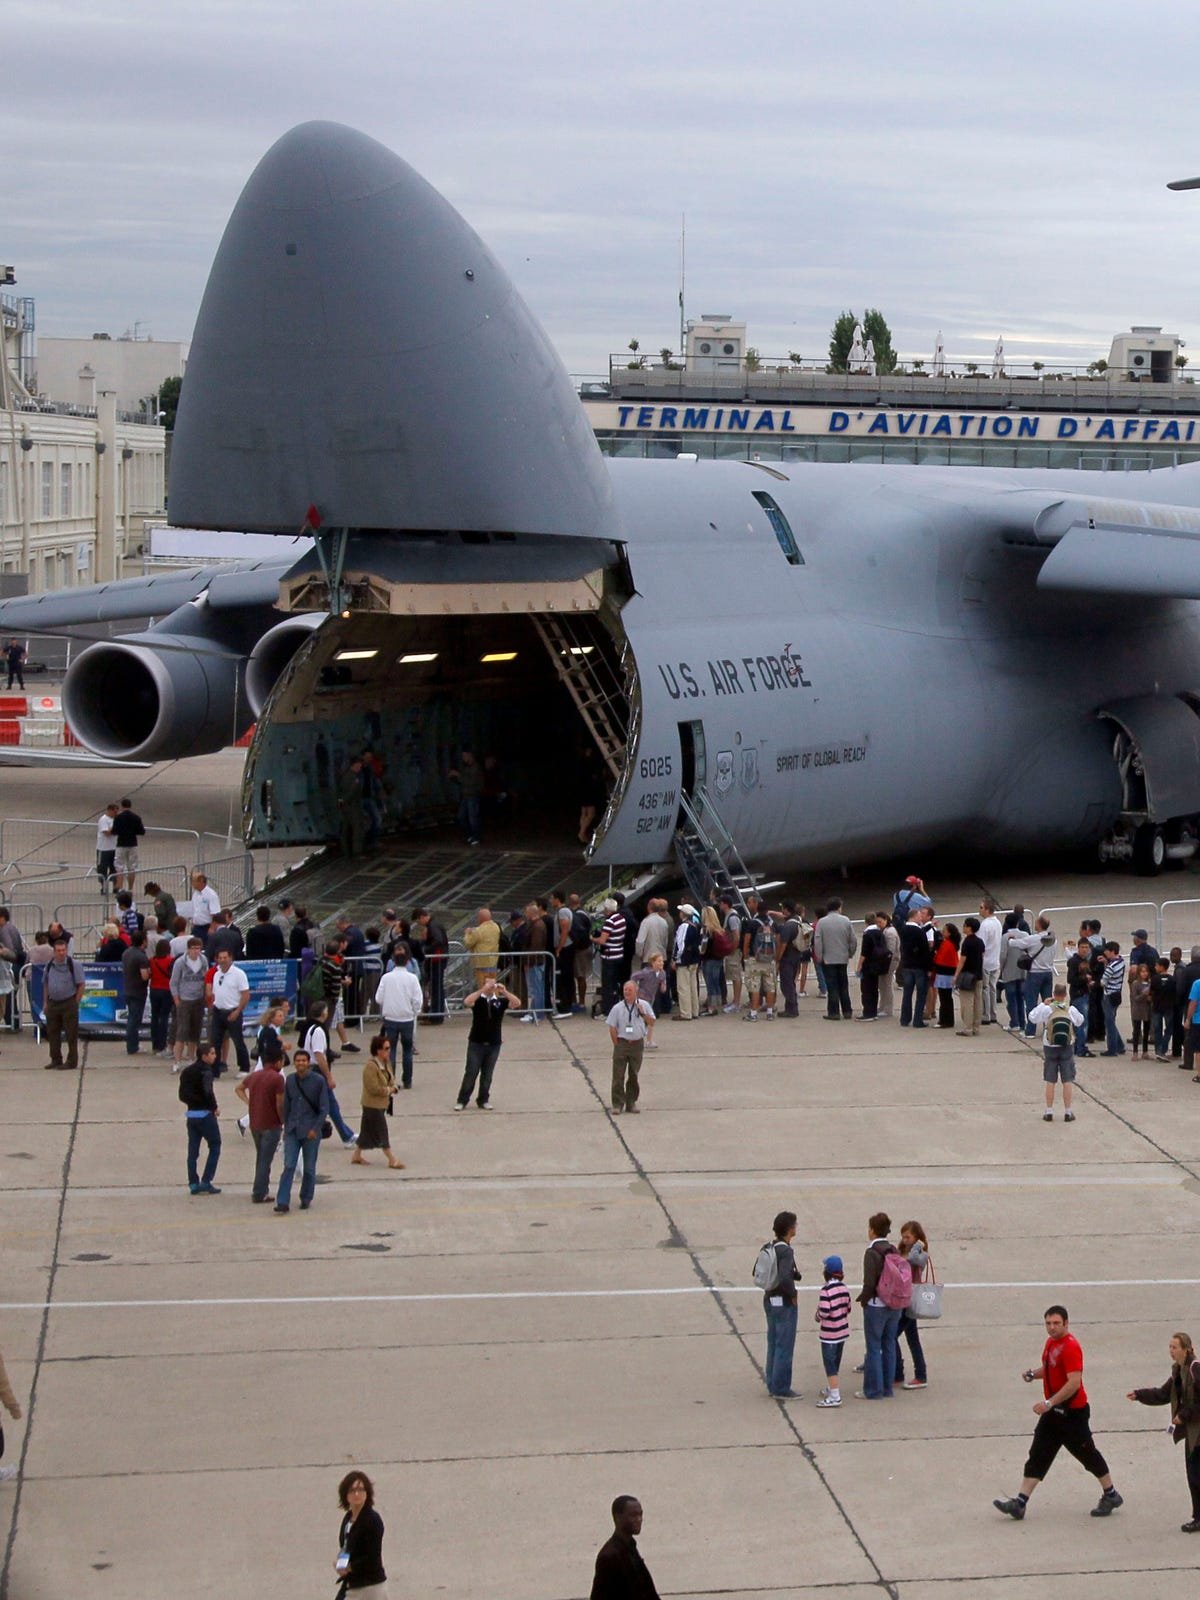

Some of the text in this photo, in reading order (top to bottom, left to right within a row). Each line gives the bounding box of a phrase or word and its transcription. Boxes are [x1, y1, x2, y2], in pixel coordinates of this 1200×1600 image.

[617, 406, 795, 431] TERMINAL
[828, 411, 1040, 438] D'AVIATION
[658, 655, 811, 699] U.S. AIR FORCE
[640, 755, 672, 779] 6025
[776, 746, 866, 773] SPIRIT OF GLOBAL REACH
[662, 790, 676, 806] AW
[657, 814, 672, 830] AW
